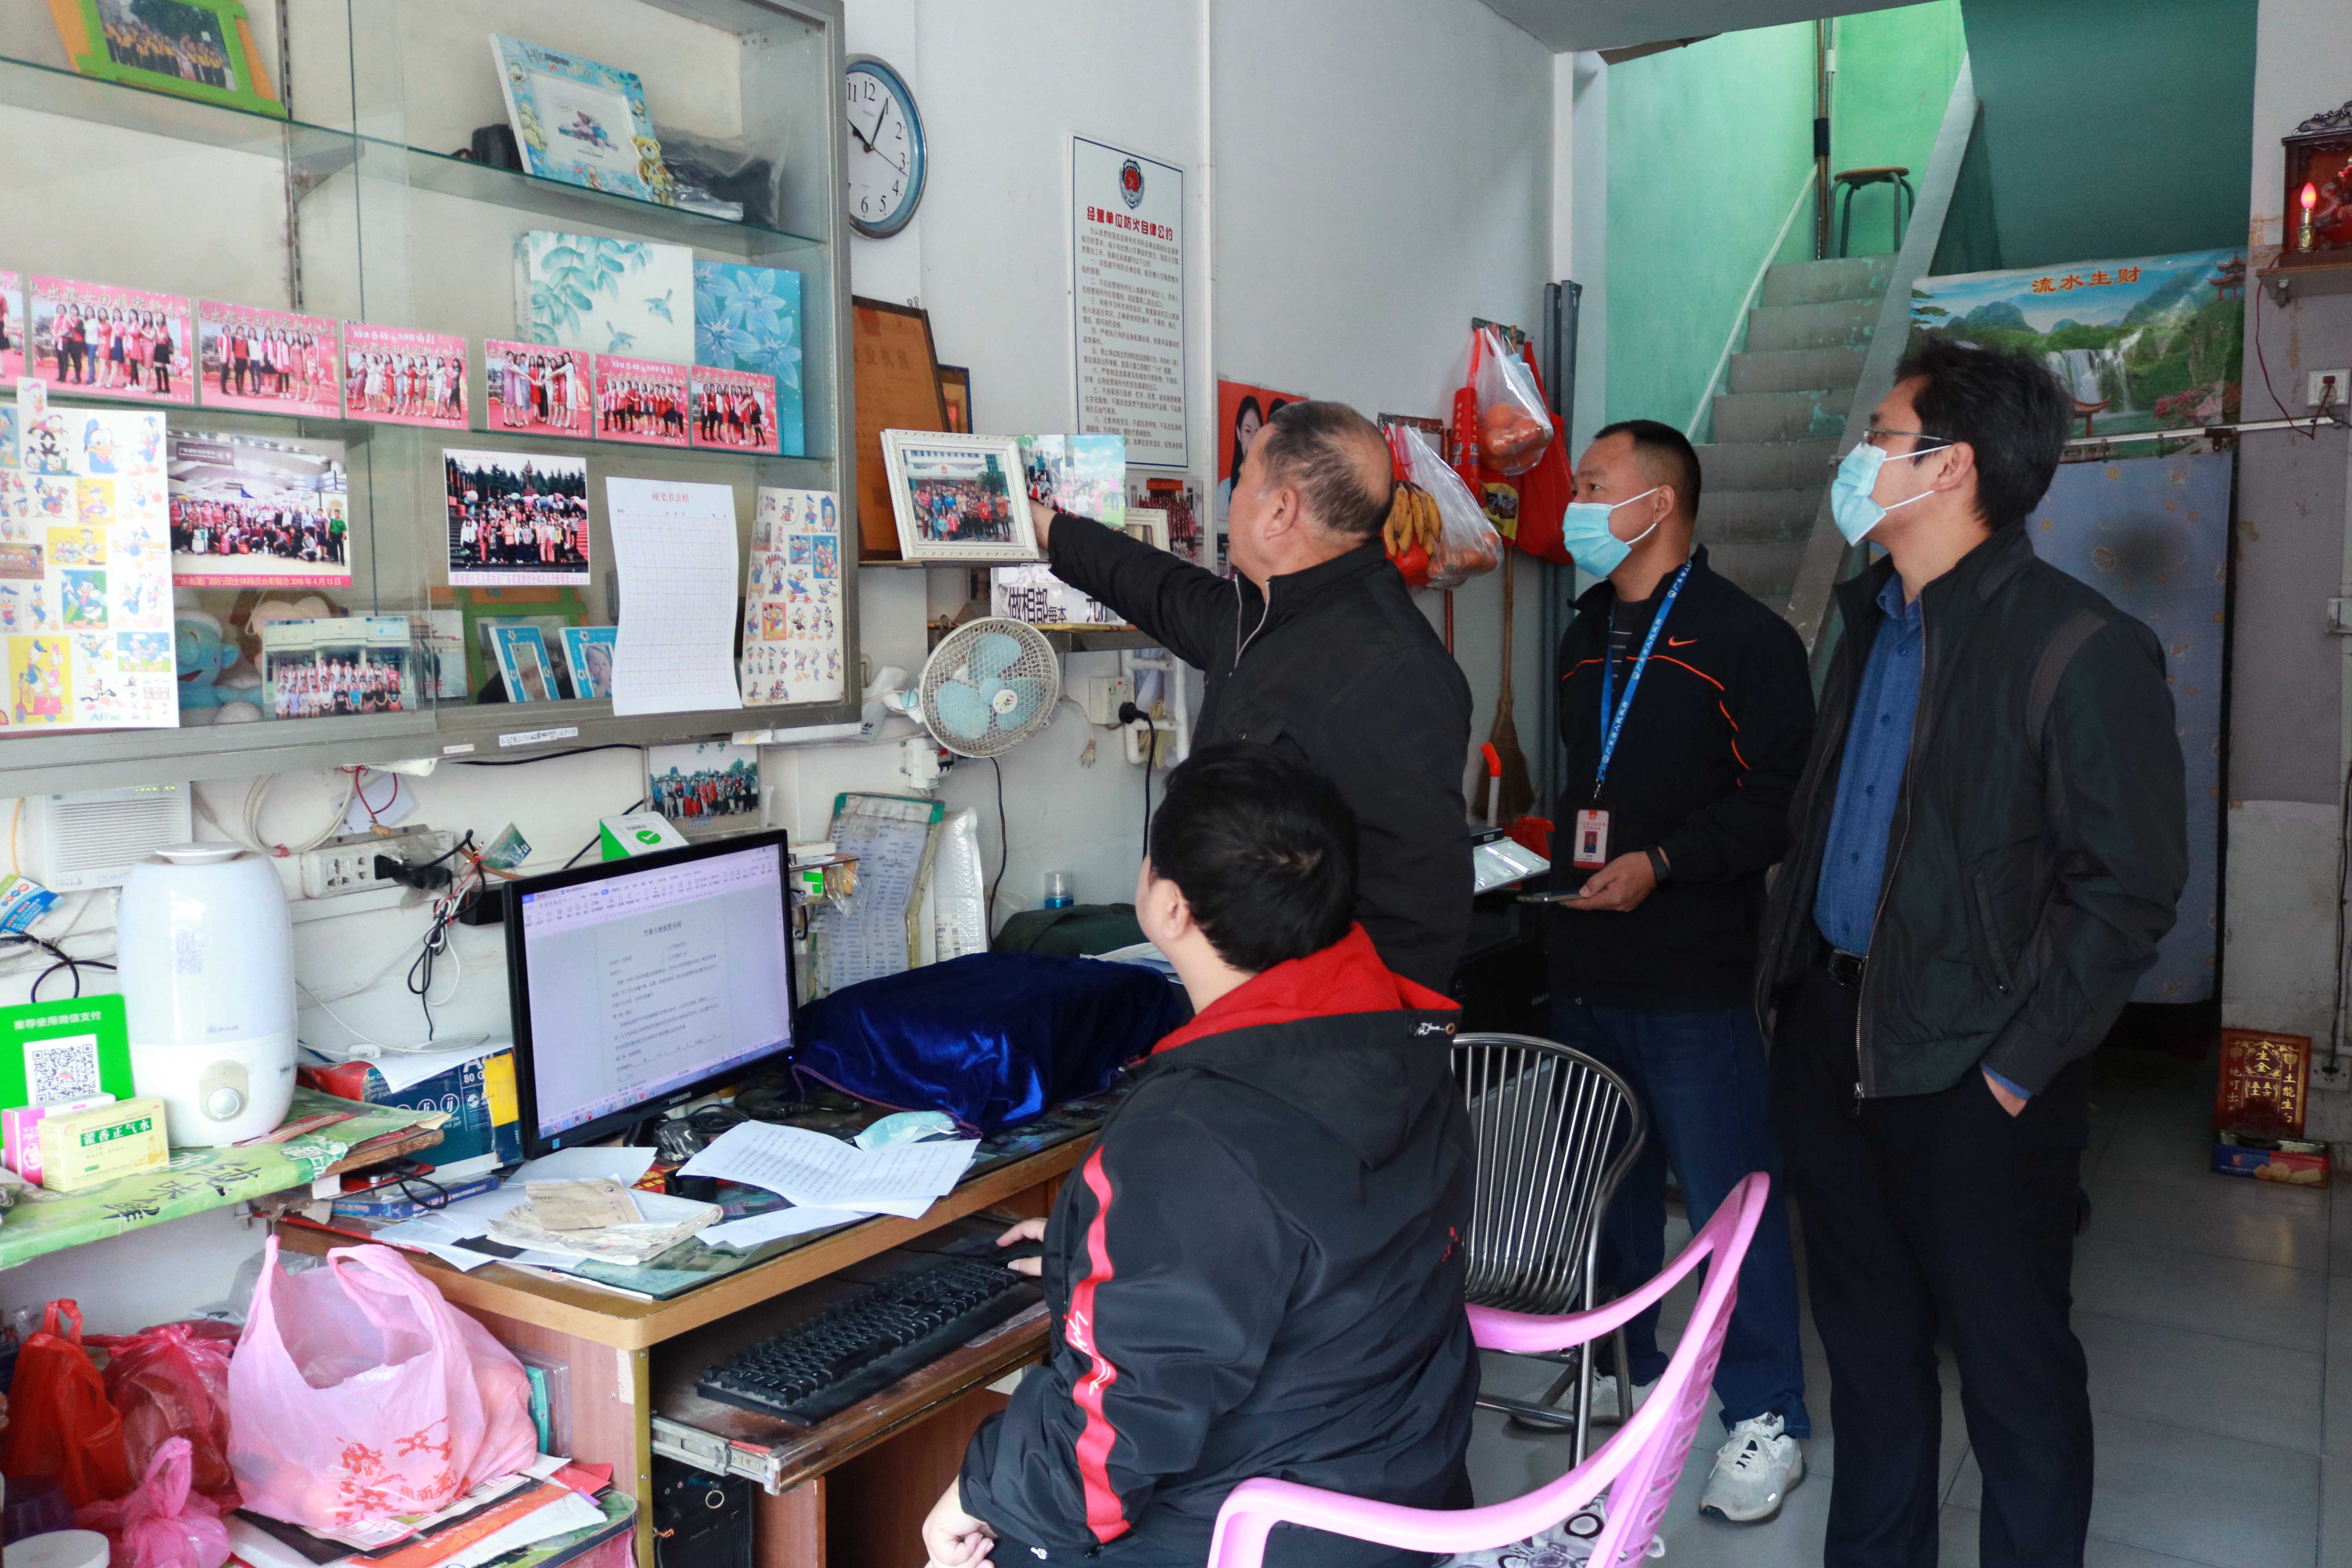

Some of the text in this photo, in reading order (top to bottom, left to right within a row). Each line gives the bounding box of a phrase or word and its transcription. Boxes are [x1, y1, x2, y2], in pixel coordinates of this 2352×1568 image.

[848, 82, 857, 102] 11
[864, 81, 875, 102] 12
[884, 97, 889, 115] 1
[895, 122, 902, 140] 2
[900, 152, 906, 170] 3
[893, 180, 899, 196] 4
[861, 196, 868, 214] 6
[879, 195, 886, 212] 5
[1087, 206, 1173, 241] 经营单位防火自律公约
[2031, 267, 2142, 294] 流水生财
[1048, 605, 1067, 624] 每本
[1635, 618, 1662, 671] 广东省人民政府
[1606, 701, 1629, 754] 广东省人民政府
[14, 1011, 102, 1030] 推荐使用微信支付
[464, 1073, 475, 1083] 80
[669, 1091, 691, 1104] SAMSUNG
[83, 1119, 151, 1146] 藿香正气水
